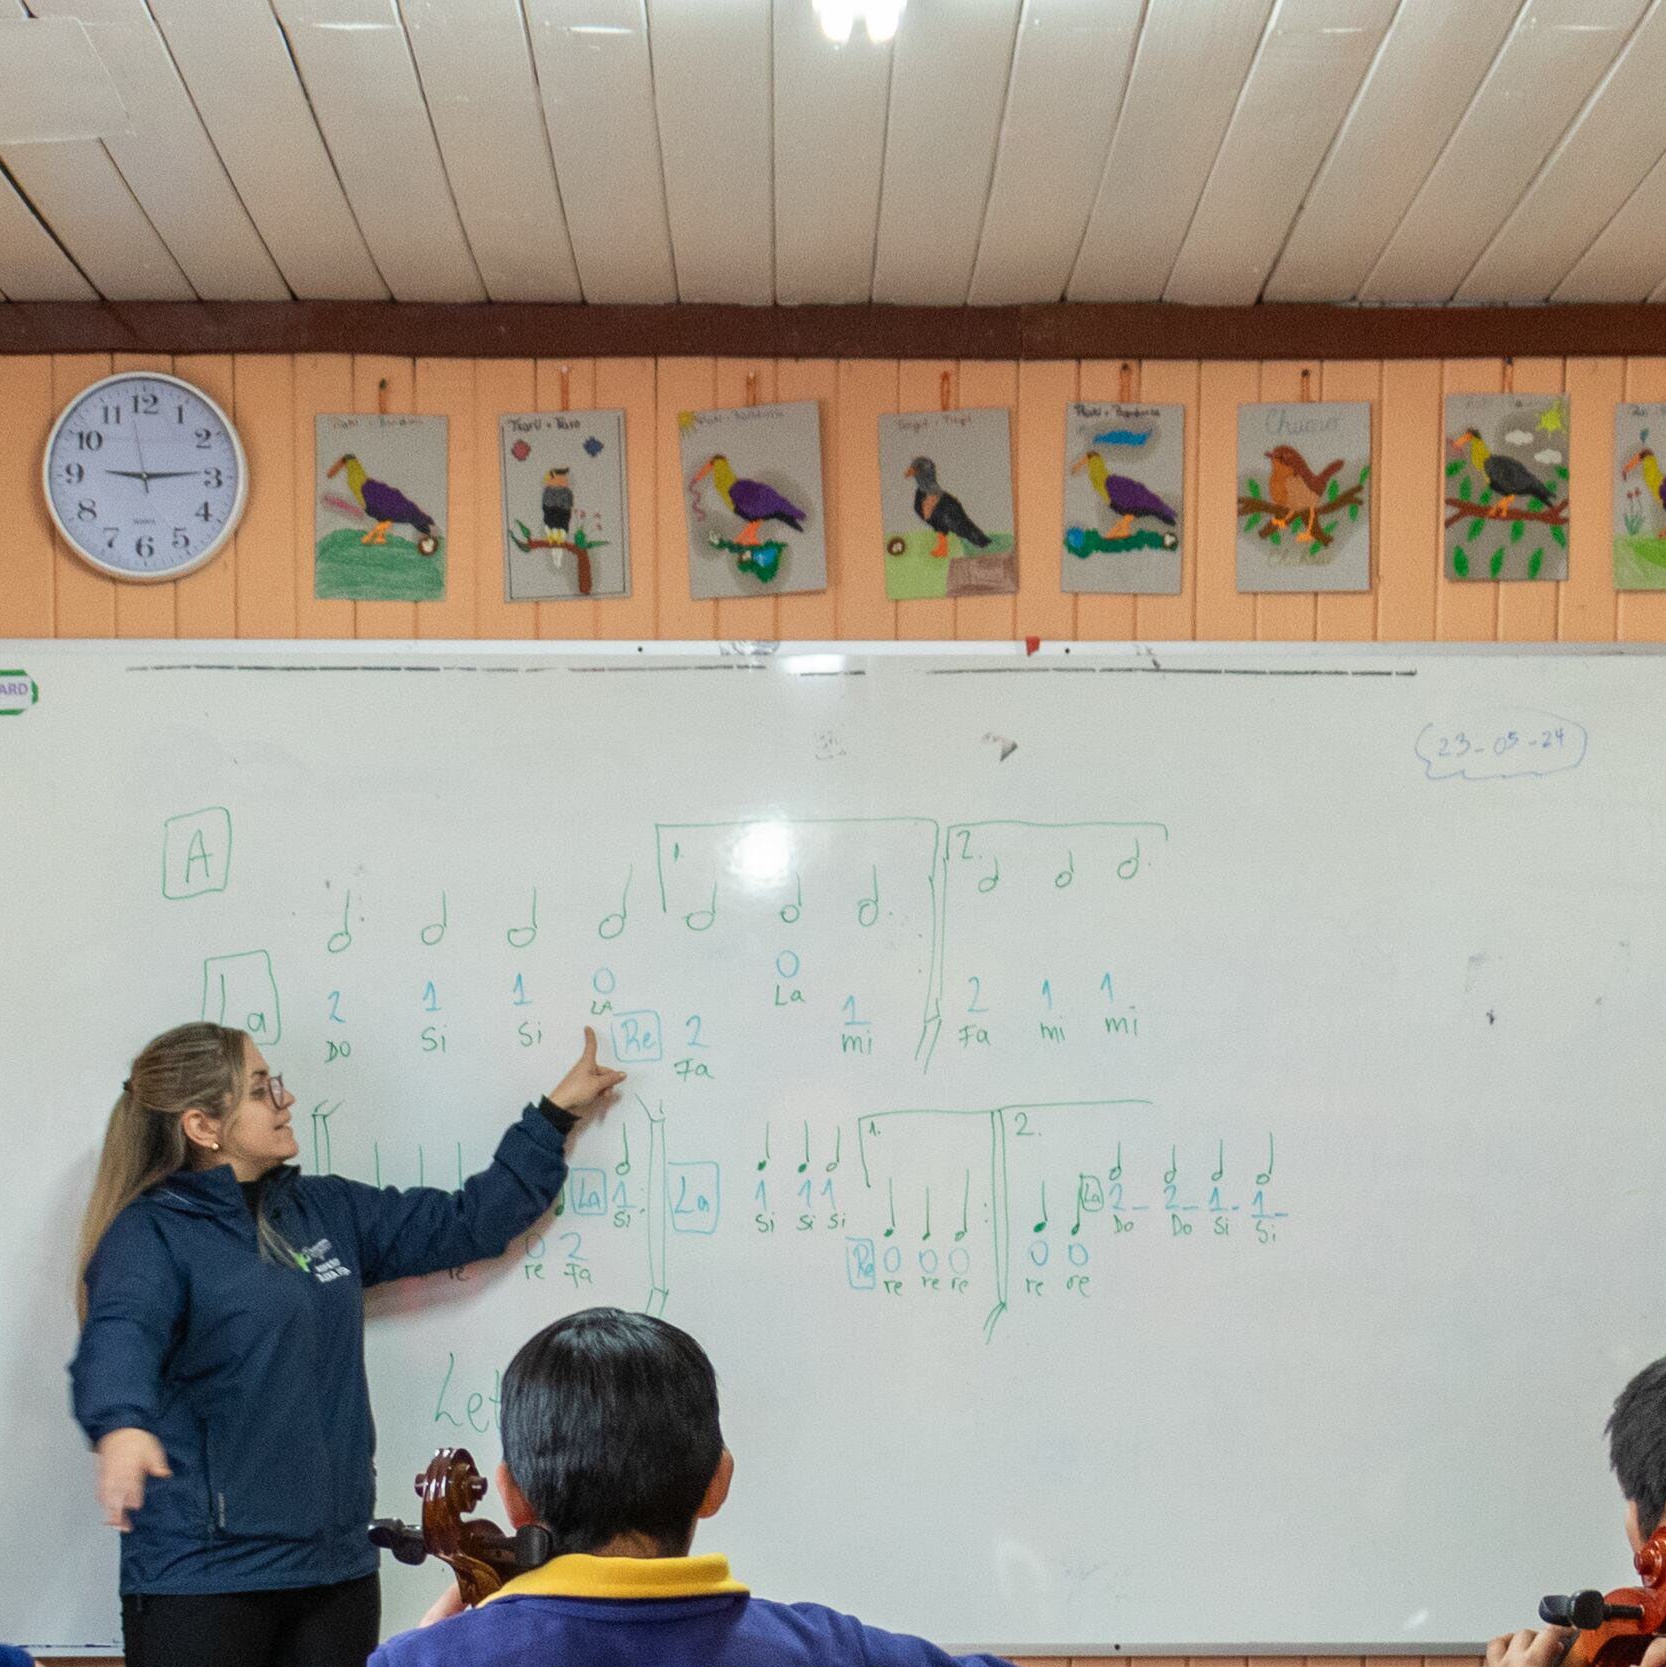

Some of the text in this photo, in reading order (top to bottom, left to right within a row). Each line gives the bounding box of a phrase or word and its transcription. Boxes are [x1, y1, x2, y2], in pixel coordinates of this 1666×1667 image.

[102, 406, 121, 425] 11
[132, 394, 159, 415] 12
[175, 405, 184, 424] 1
[77, 430, 104, 451] 10
[194, 429, 212, 449] 2
[65, 463, 85, 485] 9
[204, 467, 224, 489] 3
[77, 498, 98, 521] 8
[195, 501, 213, 522] 4
[103, 527, 120, 548] 7
[135, 535, 155, 558] 6
[172, 527, 190, 549] 5
[185, 831, 214, 884] A
[327, 991, 344, 1024] 2
[422, 981, 442, 1013] 1
[512, 973, 531, 1006] 1
[774, 983, 806, 1005] La
[966, 972, 1113, 1013] 2 1 1
[422, 1026, 447, 1053] Si
[519, 1022, 543, 1047] Si
[625, 1017, 655, 1056] Re
[685, 1015, 710, 1048] 2
[578, 1177, 601, 1210] La
[674, 1175, 710, 1215] La
[755, 1179, 767, 1210] 1
